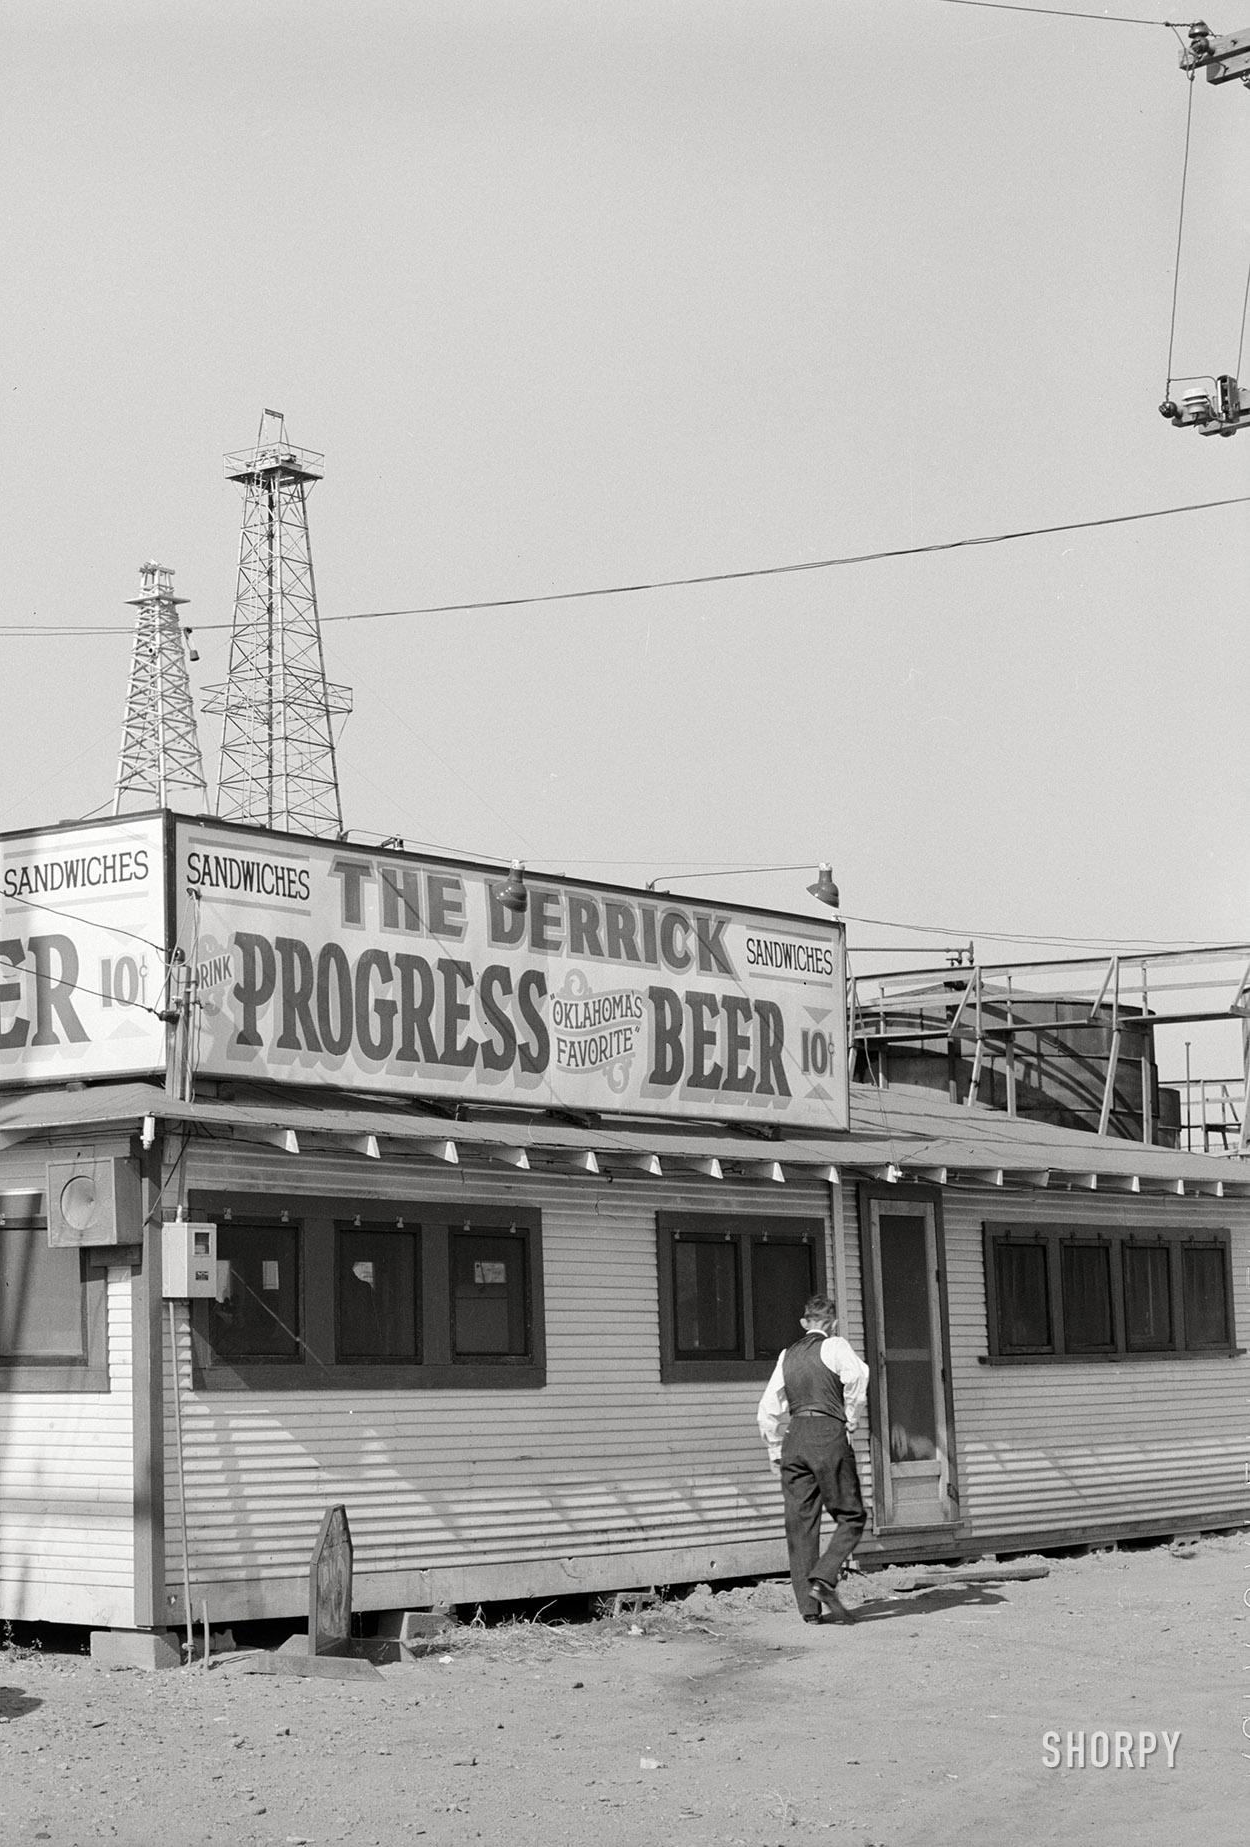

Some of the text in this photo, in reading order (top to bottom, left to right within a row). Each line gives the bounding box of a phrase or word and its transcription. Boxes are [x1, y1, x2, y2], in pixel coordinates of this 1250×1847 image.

[3, 849, 149, 899] SANDWICHES
[186, 851, 310, 901] SANDWICHES
[331, 860, 735, 975] THE DERRICK
[746, 937, 834, 977] SANDWICHES
[233, 931, 551, 1075] PROGRESS
[648, 985, 793, 1098] BEER
